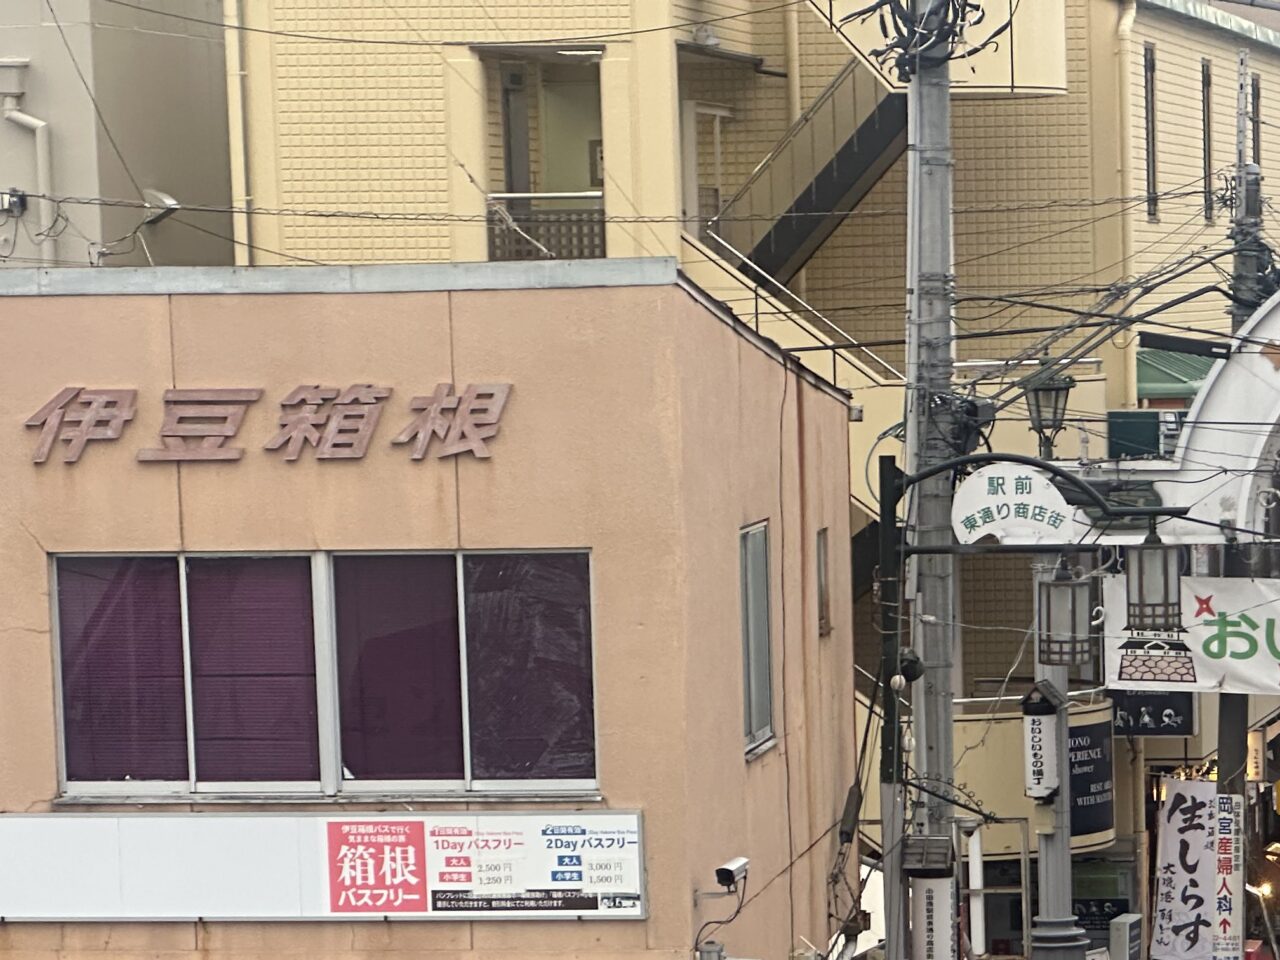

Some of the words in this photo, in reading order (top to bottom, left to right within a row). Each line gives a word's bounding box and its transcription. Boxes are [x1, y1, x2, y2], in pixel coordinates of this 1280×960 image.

[25, 382, 514, 464] 伊豆箱根
[987, 475, 1032, 495] 駅前
[961, 502, 1066, 534] 東通り商店街
[1030, 717, 1044, 785] おいしいもの横丁
[341, 824, 410, 834] 伊豆箱根バスで行く
[434, 840, 465, 853] 1Day
[468, 839, 524, 850] バスフリー
[546, 839, 577, 852] 2Day
[581, 838, 638, 849] バスフリー
[337, 845, 420, 886] 箱根
[450, 858, 466, 866] 大人
[477, 863, 500, 873] 2,500
[503, 863, 512, 872] 円
[562, 857, 578, 865] 大人
[588, 863, 611, 872] 3,000
[614, 863, 623, 872] 円
[1216, 796, 1233, 916] 岡宮産婦人科
[442, 873, 467, 882] 小学生
[479, 876, 502, 886] 1,250
[504, 876, 513, 885] 円
[555, 872, 580, 881] 小学生
[589, 875, 612, 884] 1,500
[614, 874, 623, 884] 円
[1166, 792, 1212, 952] 生しらす
[338, 888, 420, 907] バスフリー
